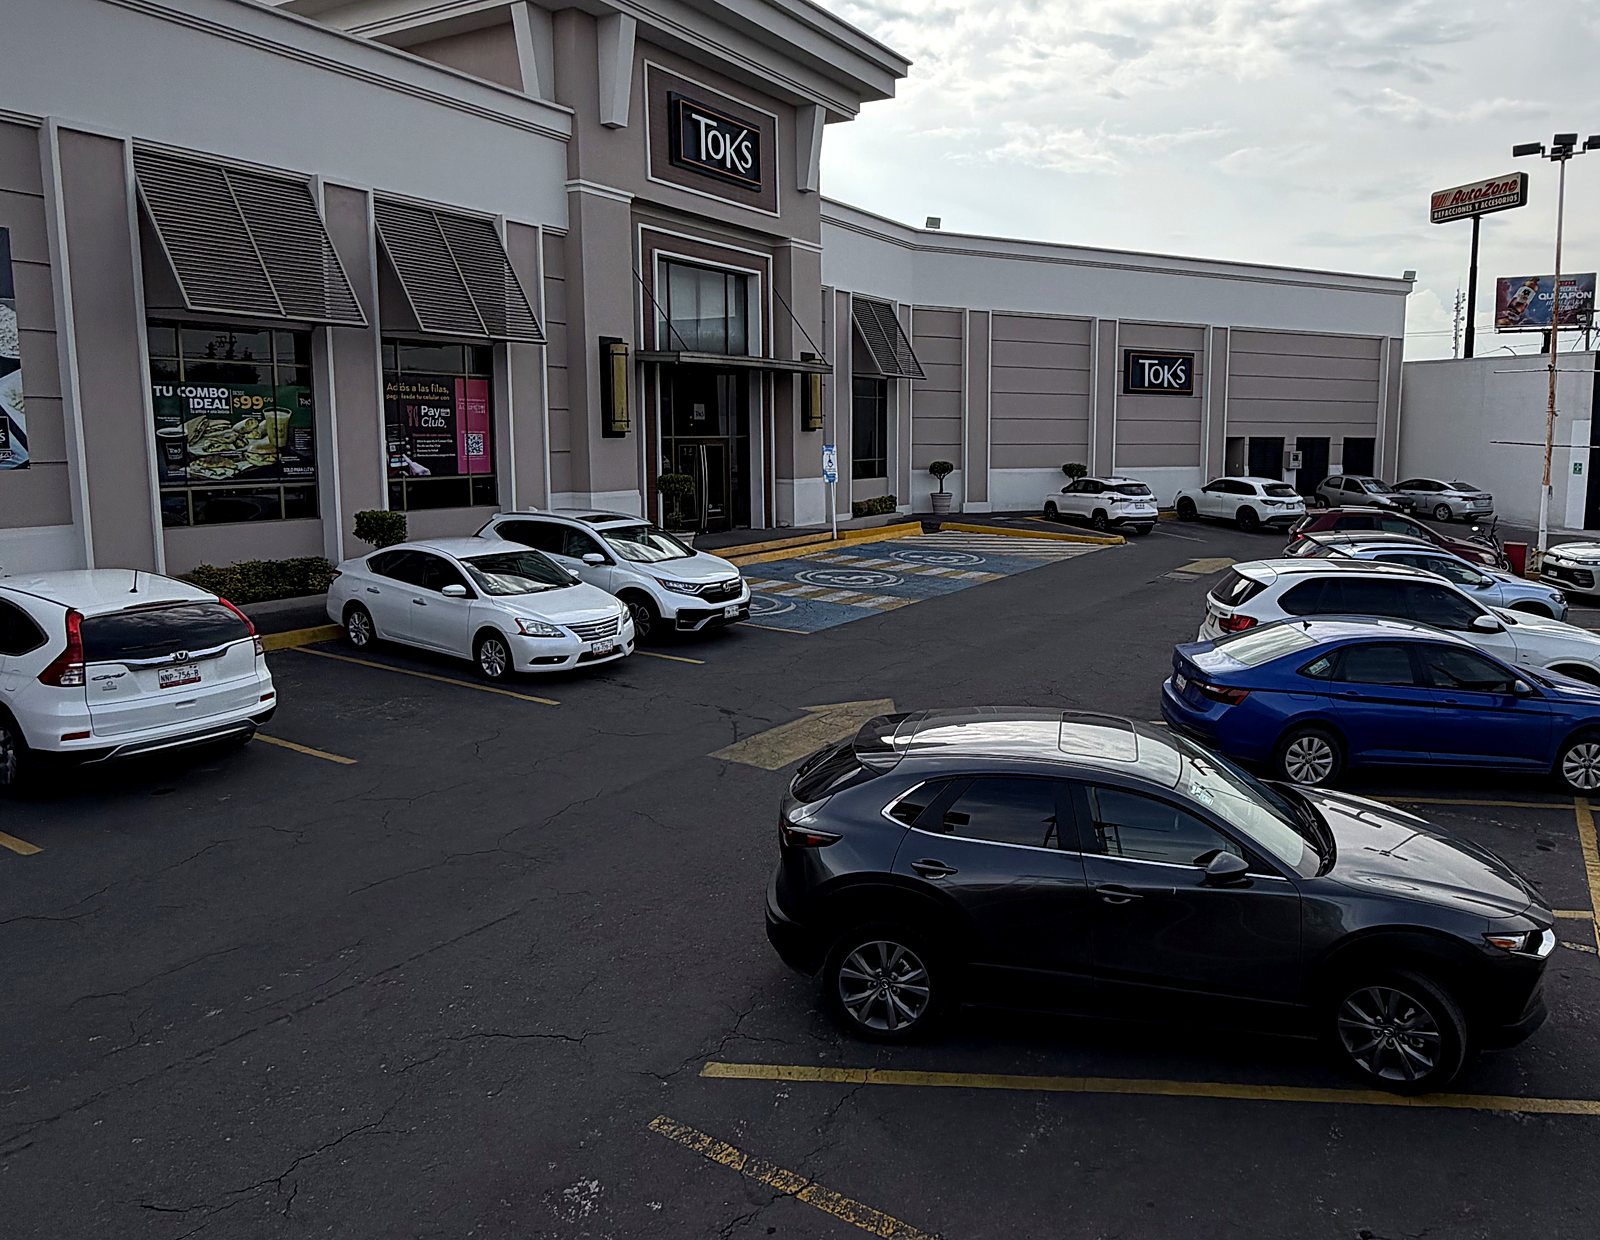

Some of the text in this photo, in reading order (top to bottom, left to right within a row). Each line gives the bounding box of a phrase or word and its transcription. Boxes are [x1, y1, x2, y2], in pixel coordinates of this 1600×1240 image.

[1451, 179, 1519, 205] AutoZone
[1434, 204, 1473, 218] REFACCIONES
[1481, 193, 1518, 208] ACCESORIOS
[153, 385, 229, 398] TU COMBO
[418, 383, 430, 393] las
[189, 398, 230, 409] IDEAL
[233, 395, 264, 409] $99
[421, 405, 440, 418] Pay
